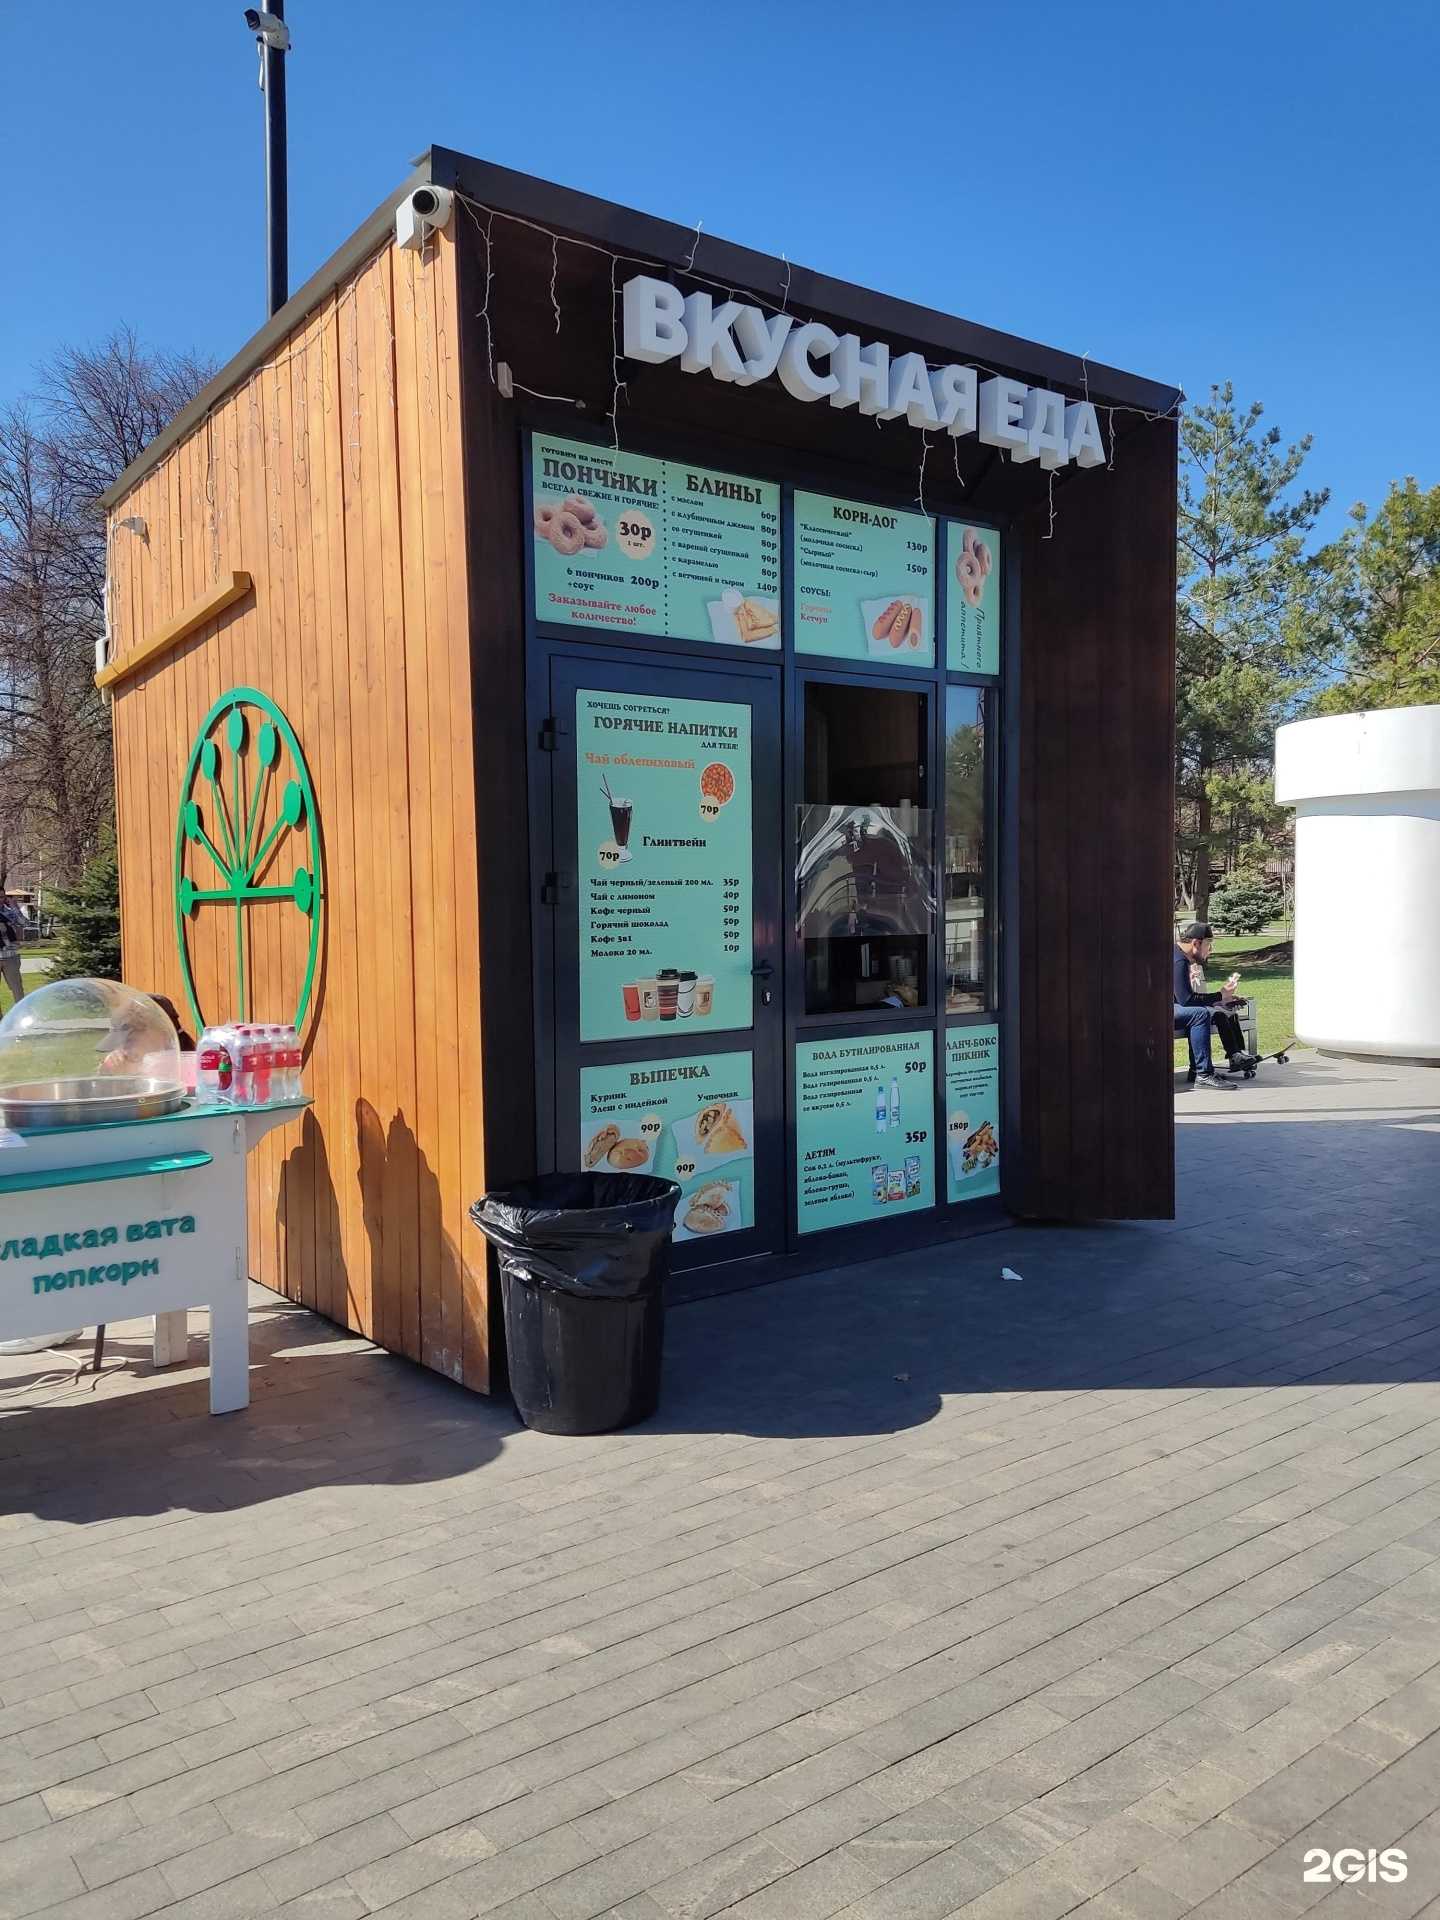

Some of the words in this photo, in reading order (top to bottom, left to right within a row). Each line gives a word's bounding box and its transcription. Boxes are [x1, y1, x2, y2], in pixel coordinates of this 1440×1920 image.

[623, 275, 977, 435] ВКУСНАЯ
[979, 375, 1106, 470] ЕДА
[541, 446, 576, 459] готовим
[591, 456, 613, 466] месте
[543, 458, 658, 497] ПОНЧИКИ
[542, 482, 575, 494] ВСЕГДА
[577, 488, 612, 502] СВЕЖИЕ
[686, 474, 762, 505] БЛИНЫ
[677, 497, 704, 507] маслом
[761, 511, 777, 522] 60р
[677, 512, 725, 526] клубничным
[726, 522, 755, 531] джемом
[761, 525, 777, 536] 80р
[833, 506, 898, 529] КОРН-ДОГ
[620, 522, 652, 541] 30р
[681, 527, 722, 540] сгущенкой
[761, 540, 777, 550] 80р
[677, 542, 708, 552] вареной
[710, 548, 749, 559] сгущенкой
[761, 555, 777, 565] 90р
[906, 541, 928, 553] 130р
[678, 557, 719, 569] карамелью
[761, 568, 777, 579] 80р
[906, 563, 928, 575] 150р
[567, 567, 573, 575] 6
[575, 569, 625, 583] пончиков
[630, 576, 660, 589] 200р
[678, 572, 713, 583] ветчиной
[721, 578, 745, 588] сыром
[757, 582, 778, 593] 140р
[568, 582, 595, 591] +соус
[800, 586, 831, 597] СОУСЫ:
[548, 593, 622, 610] Заказывайте
[624, 603, 657, 616] любое
[571, 611, 636, 625] количество!
[800, 614, 828, 624] Кетчуп
[974, 608, 985, 669] Приятного
[587, 701, 621, 711] ХОЧЕШЬ
[594, 716, 664, 733] ГОРЯЧИЕ
[668, 722, 738, 739] НАПИТКИ
[700, 741, 716, 749] ДЛЯ
[718, 742, 739, 750] ТЕБЯ!
[586, 752, 609, 764] Чай
[614, 753, 695, 769] облепиховый
[701, 805, 719, 815] 70р
[643, 836, 706, 847] Глинтвейн
[600, 852, 620, 862] 70р
[590, 879, 607, 887] Чай
[610, 878, 683, 887] черный/зеленый
[723, 878, 739, 887] 35р
[590, 893, 607, 901] Чай
[723, 892, 739, 900] 40р
[590, 907, 615, 916] Кофе
[617, 906, 651, 914] черный
[723, 905, 739, 913] 50р
[590, 921, 629, 930] Горячий
[723, 918, 739, 926] 50р
[590, 935, 615, 944] Кофе
[723, 931, 740, 939] 50р
[591, 949, 624, 957] Молоко
[724, 944, 740, 952] 10р
[946, 1036, 997, 1050] ЛАНЧ-БОКС
[812, 1051, 837, 1061] ВОДА
[840, 1042, 920, 1058] БУТИЛИРОВАННАЯ
[952, 1049, 990, 1061] ПИКНИК
[905, 1060, 927, 1073] 50р
[630, 1064, 710, 1086] ВЫПЕЧКА
[819, 1078, 862, 1087] газированная
[590, 1092, 627, 1103] Курник
[697, 1090, 739, 1102] Учпочмак
[820, 1089, 863, 1099] газированная
[590, 1104, 616, 1113] Элеш
[625, 1097, 668, 1109] индейкой
[641, 1123, 660, 1133] 90р
[950, 1121, 968, 1131] 180р
[905, 1131, 927, 1143] 35р
[805, 1148, 836, 1160] ДЕТЯМ
[676, 1163, 695, 1173] 90р
[0, 1226, 117, 1260] ладкая
[127, 1215, 195, 1243] вата
[33, 1258, 159, 1295] попкорн
